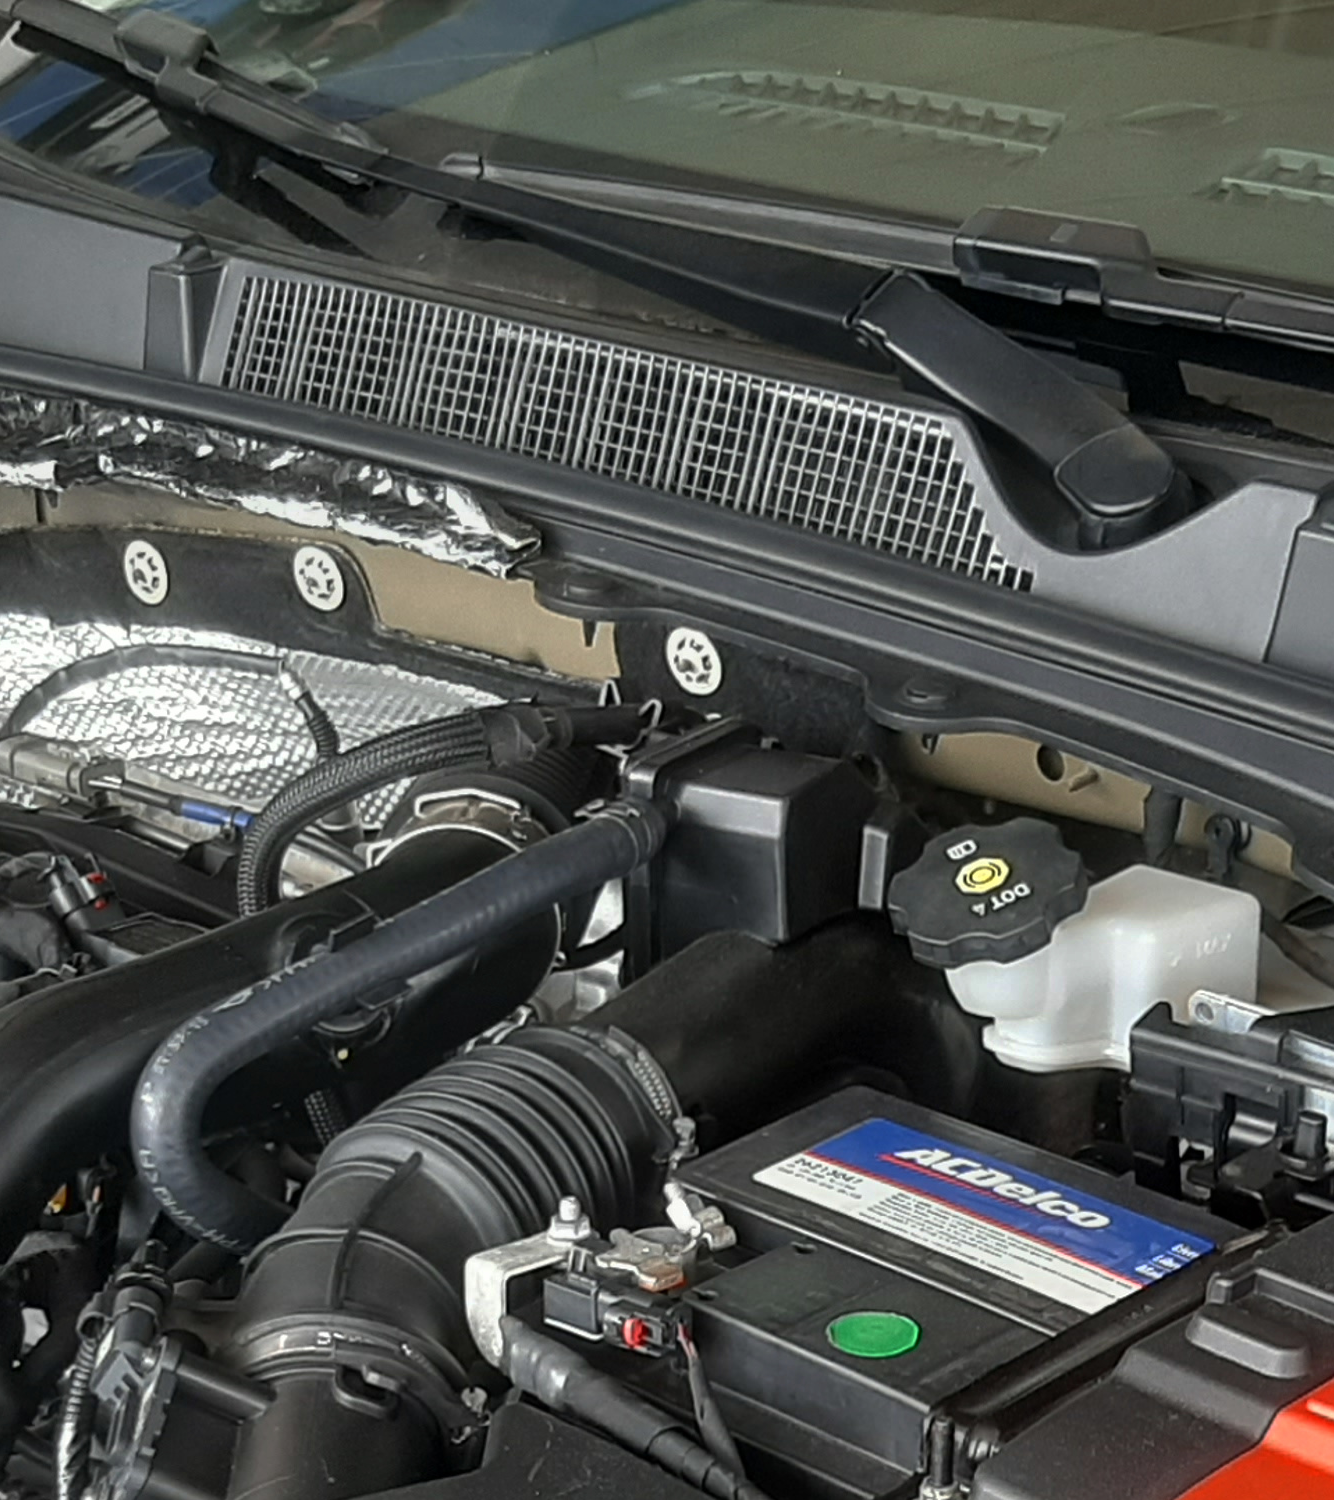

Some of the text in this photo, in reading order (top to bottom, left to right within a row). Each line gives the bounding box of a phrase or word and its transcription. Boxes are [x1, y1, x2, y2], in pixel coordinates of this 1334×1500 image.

[971, 883, 1031, 917] DOT 4
[893, 1148, 1111, 1229] ACDelco
